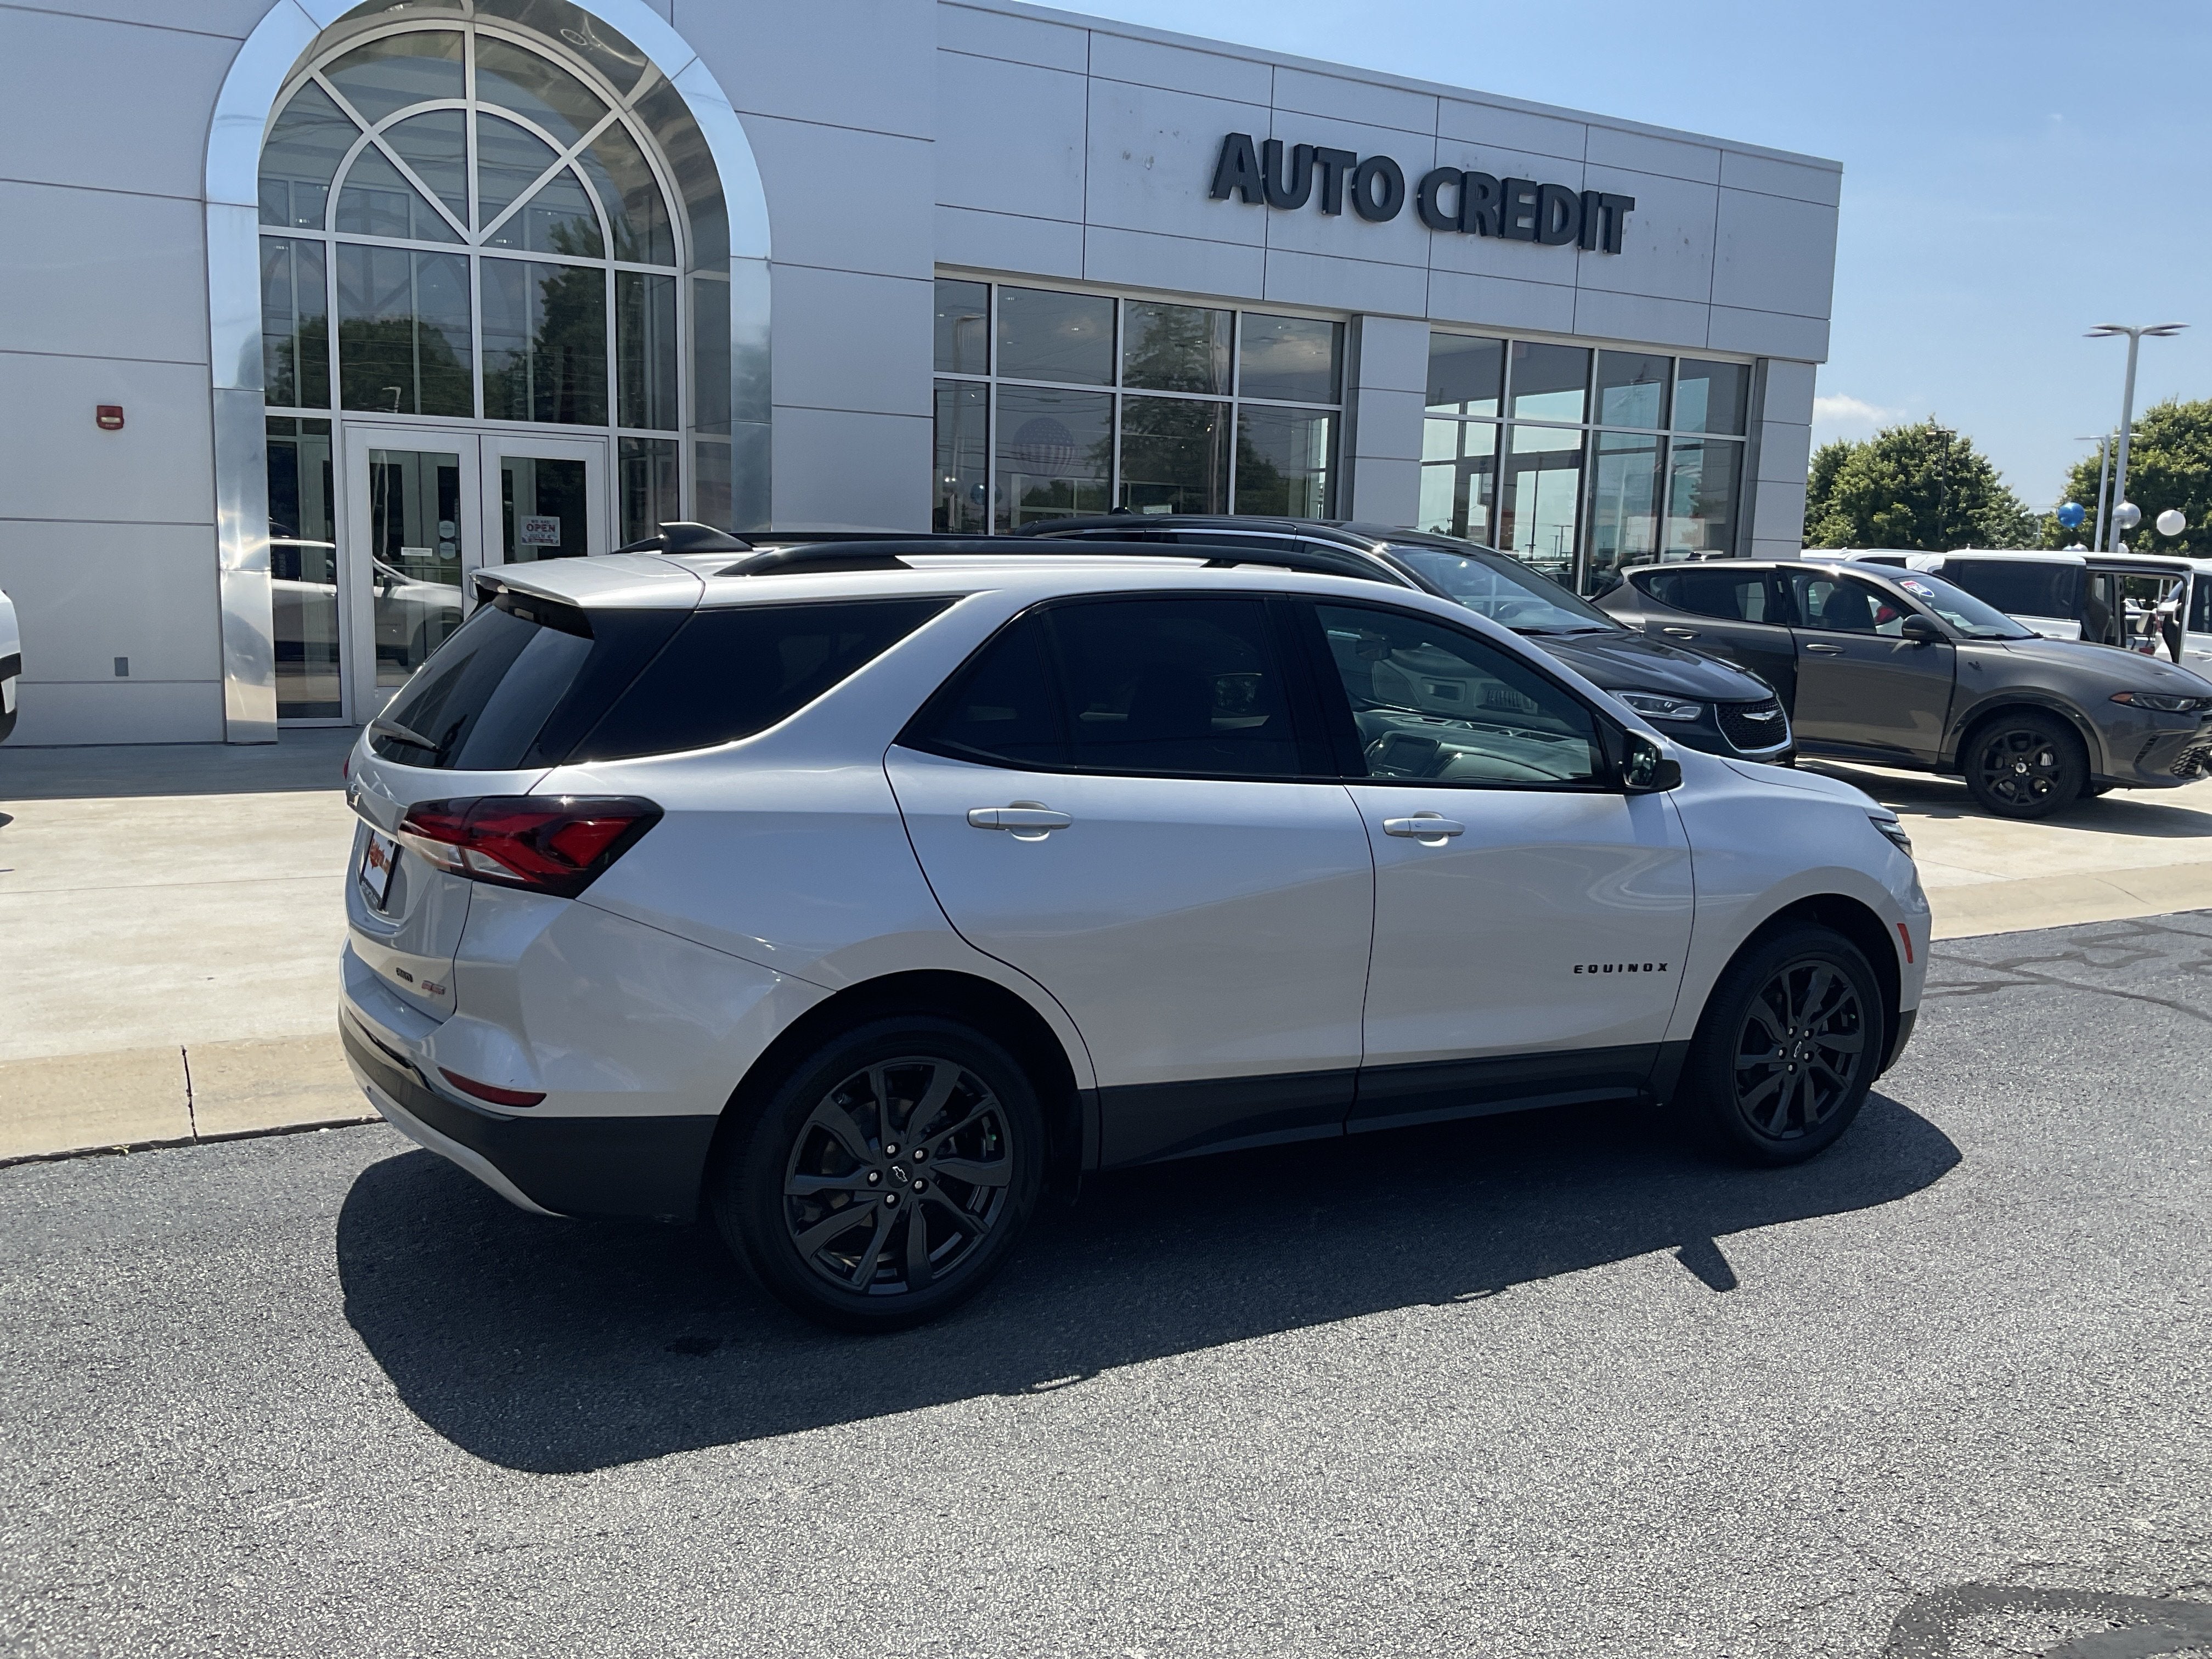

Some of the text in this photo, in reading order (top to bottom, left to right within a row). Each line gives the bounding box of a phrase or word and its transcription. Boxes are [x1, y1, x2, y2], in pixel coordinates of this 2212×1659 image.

[1209, 132, 1635, 255] AUTO CREDIT
[527, 523, 556, 532] OPEN
[1573, 963, 1668, 974] EQUINOX
